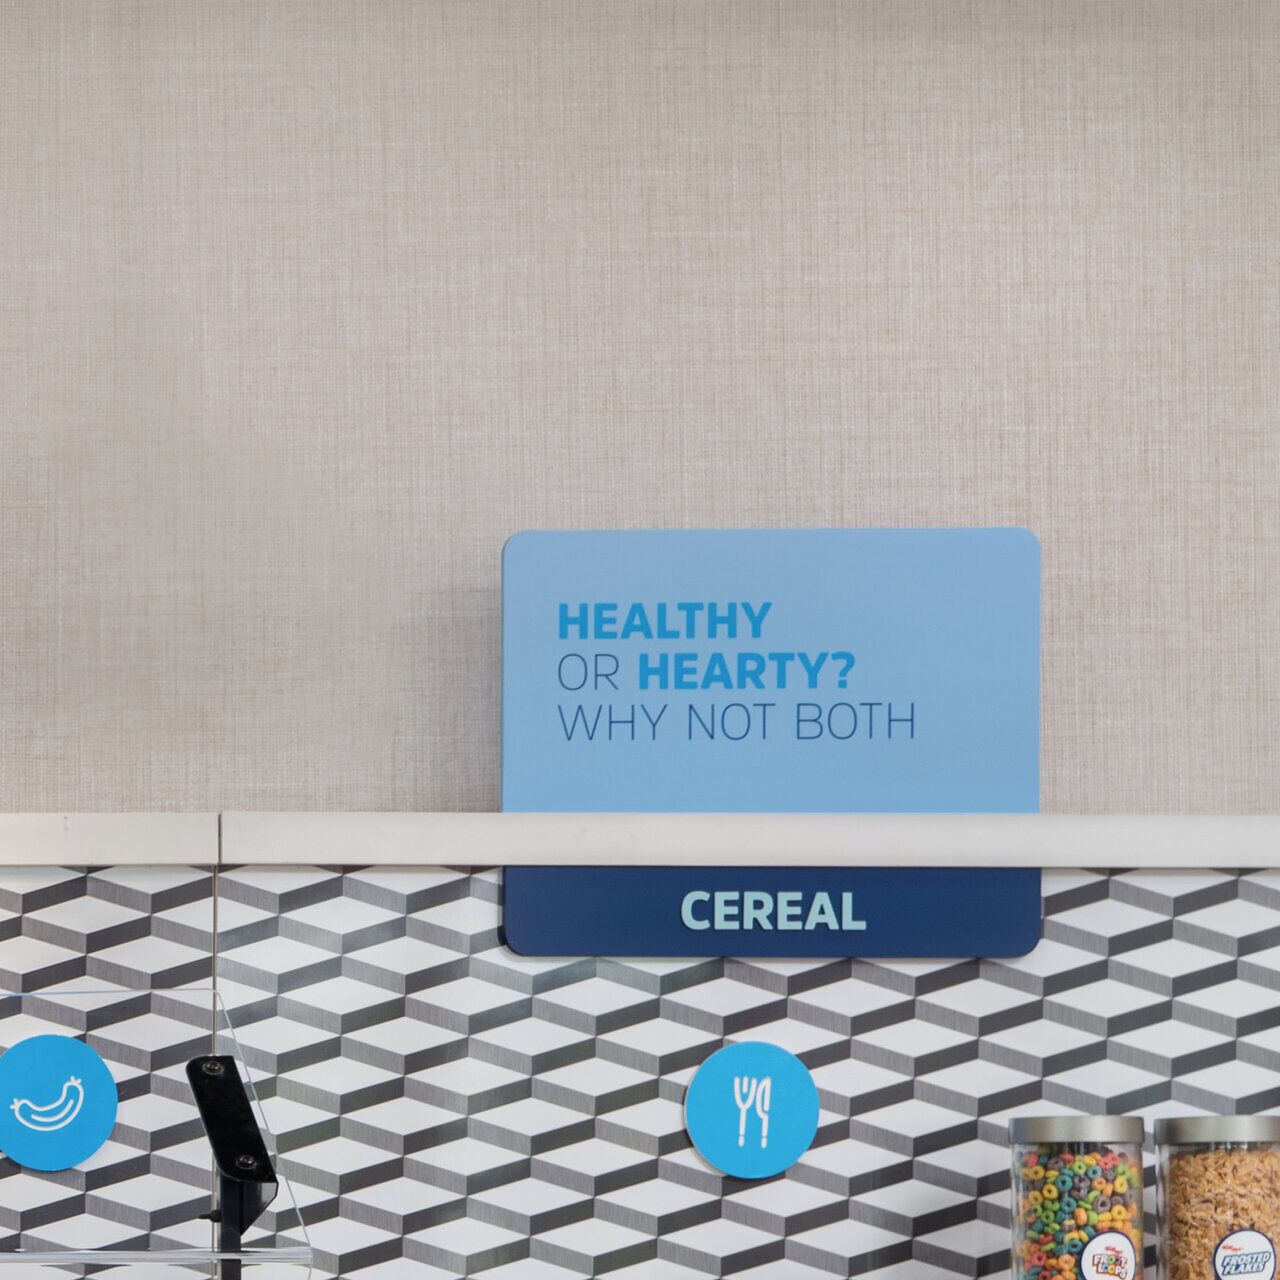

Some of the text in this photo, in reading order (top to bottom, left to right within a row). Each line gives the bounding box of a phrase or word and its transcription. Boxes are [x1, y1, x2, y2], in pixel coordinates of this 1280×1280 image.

[558, 601, 773, 640] HEALTHY
[557, 650, 856, 692] OR HEARTY?
[557, 702, 915, 742] WHY NOT BOTH
[680, 890, 868, 932] CEREAL
[1222, 1251, 1272, 1267] FROSTED
[1222, 1262, 1265, 1276] FLAKES
